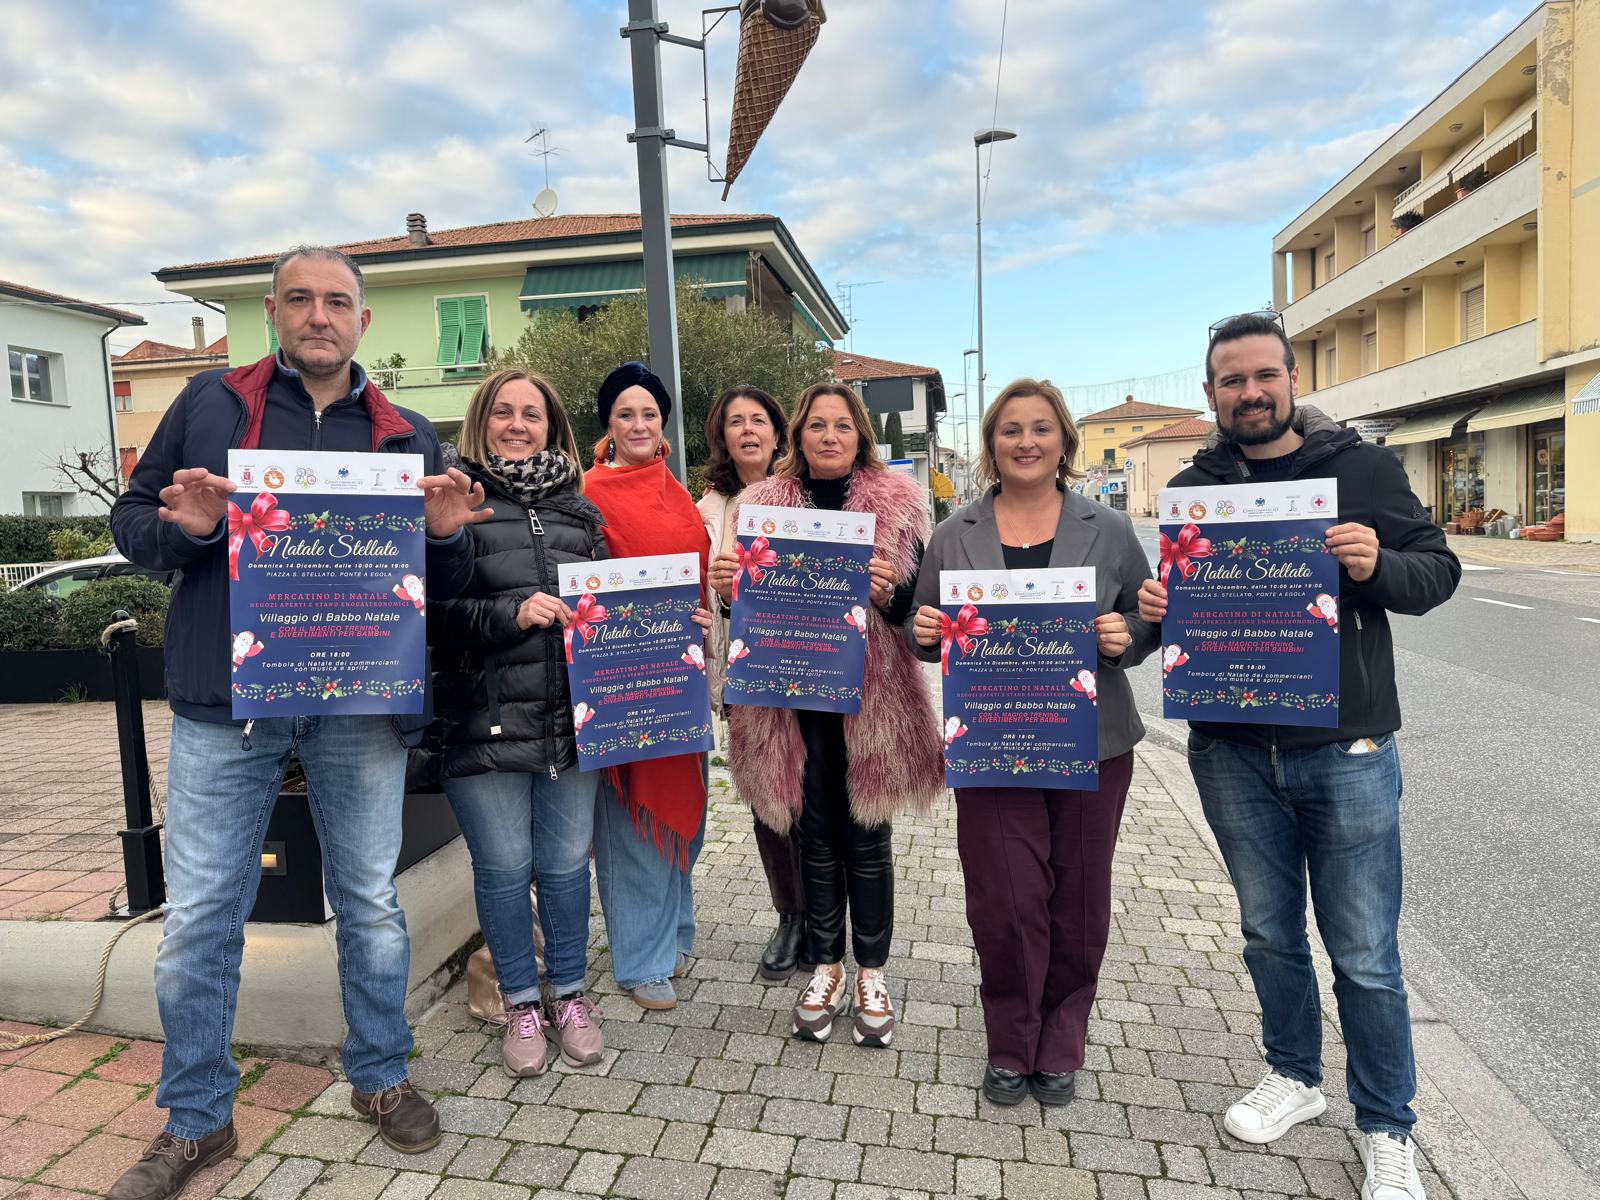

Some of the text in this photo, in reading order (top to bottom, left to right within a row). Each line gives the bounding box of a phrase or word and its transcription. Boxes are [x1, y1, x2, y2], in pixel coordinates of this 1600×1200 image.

[259, 535, 399, 559] Natale Stellato
[1185, 558, 1313, 582] Natale Stellato
[754, 569, 851, 591] Natale Stellato
[260, 613, 400, 624] Villaggio di Babbo Natale
[755, 612, 799, 620] MERCATINO
[585, 619, 684, 644] Natale Stellato
[749, 627, 782, 636] Villaggio
[795, 630, 819, 639] Babbo
[822, 633, 848, 641] Natale
[1185, 629, 1313, 638] Villaggio di Babbo Natale
[964, 637, 1075, 658] Natale Stellato
[594, 666, 638, 676] MERCATINO
[590, 684, 624, 694] Villaggio
[636, 679, 661, 687] Babbo
[664, 675, 689, 684] Natale
[964, 702, 1002, 711] Villaggio
[1046, 702, 1076, 710] Natale
